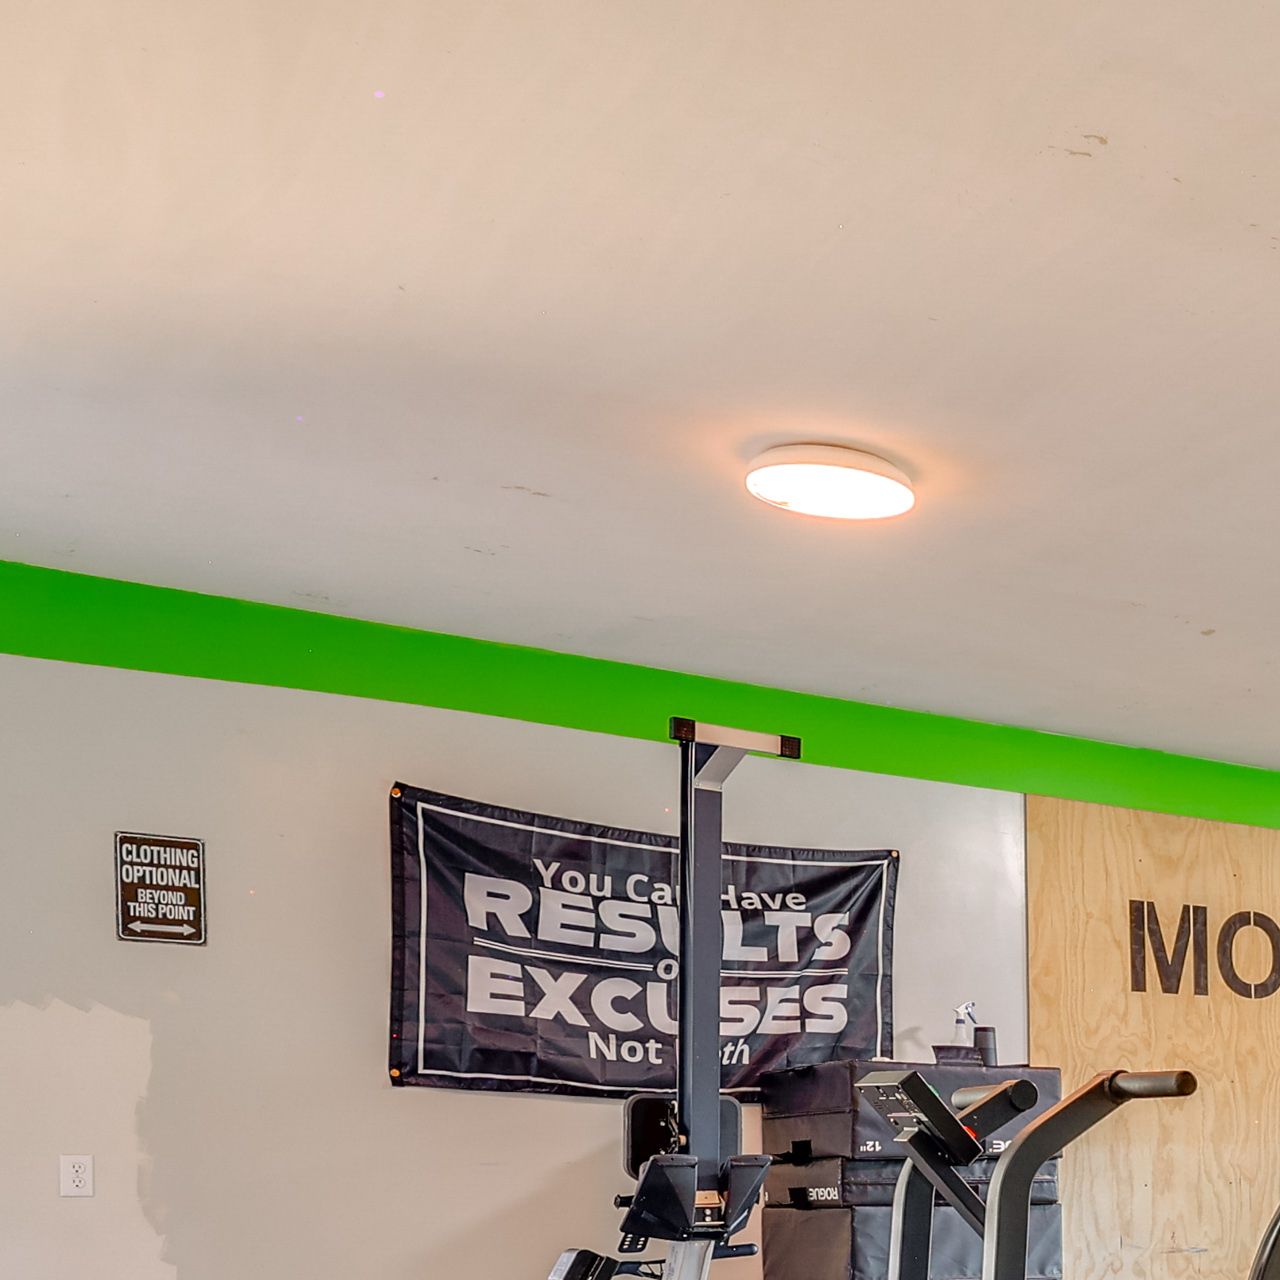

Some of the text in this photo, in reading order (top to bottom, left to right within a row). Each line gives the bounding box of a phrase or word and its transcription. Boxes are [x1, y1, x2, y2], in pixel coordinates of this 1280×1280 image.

[121, 843, 199, 868] CLOTHING
[121, 864, 200, 889] OPTIONAL
[532, 857, 612, 899] You
[626, 873, 680, 906] Ca
[137, 888, 185, 905] BEYOND
[127, 902, 196, 921] THIS POINT
[588, 1030, 662, 1065] Not
[808, 1187, 839, 1201] ROGUE
